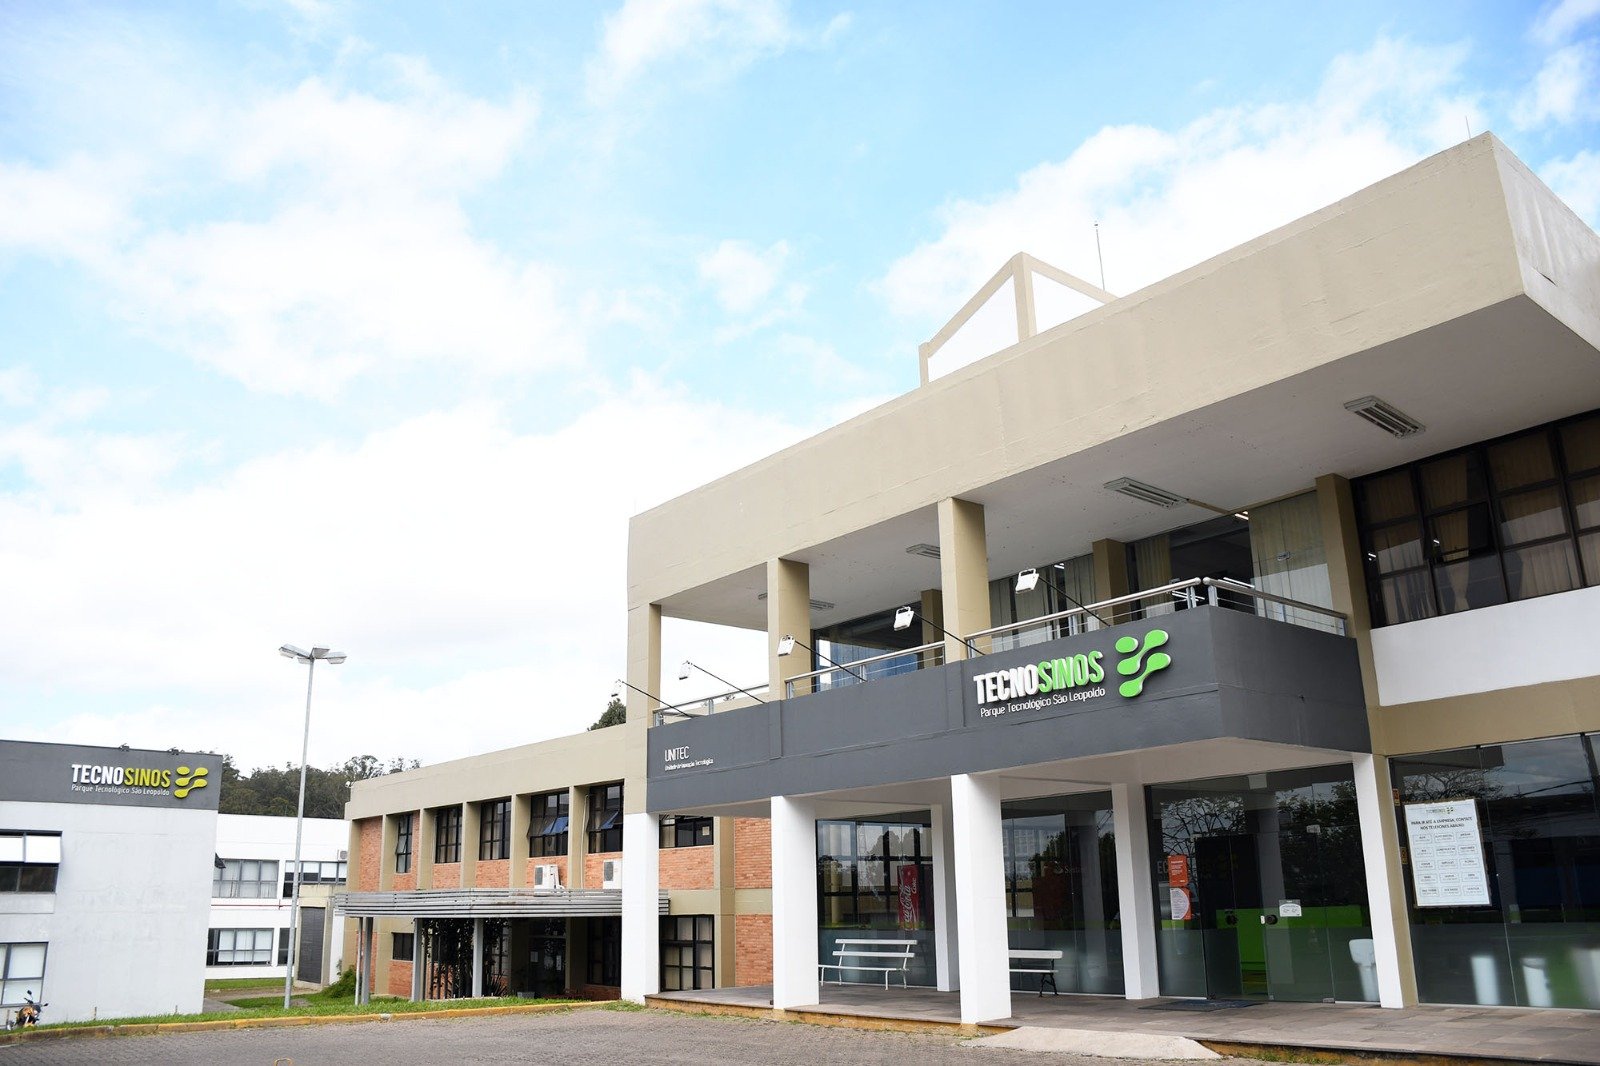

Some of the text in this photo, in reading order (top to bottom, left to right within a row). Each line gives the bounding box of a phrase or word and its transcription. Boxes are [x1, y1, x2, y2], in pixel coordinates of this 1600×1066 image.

[973, 650, 1105, 705] TECNOSINOS
[980, 687, 1106, 718] Parque Tecnológico São Leopoldo
[664, 746, 689, 761] UNITEC
[71, 764, 172, 788] TECNOSINOS
[71, 785, 170, 797] Parque Tecnológico São Leopoldo
